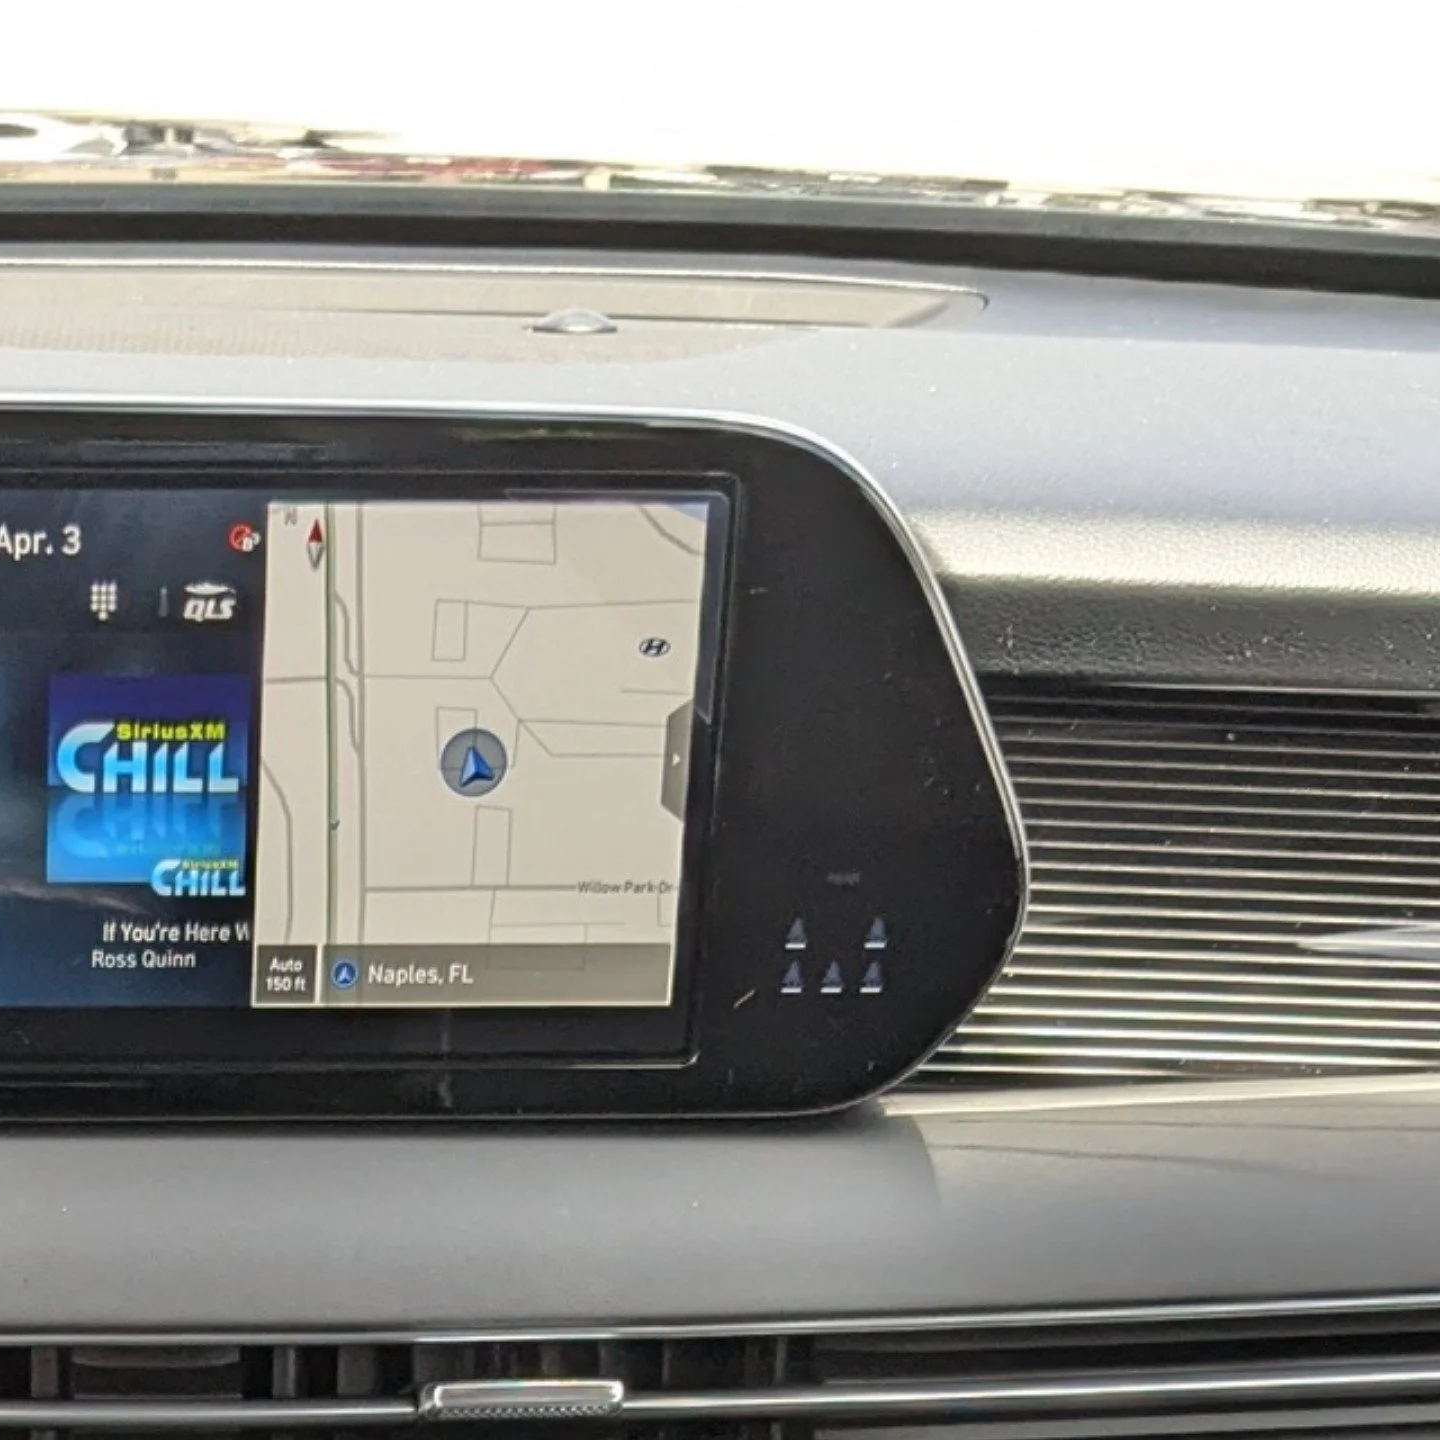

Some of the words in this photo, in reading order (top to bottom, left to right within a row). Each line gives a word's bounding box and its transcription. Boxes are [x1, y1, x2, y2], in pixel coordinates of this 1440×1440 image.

[62, 526, 82, 555] 3
[57, 722, 239, 793] CHILL
[151, 859, 246, 896] CHILL
[624, 880, 653, 893] Park
[103, 921, 116, 941] If
[121, 922, 180, 942] You're
[184, 922, 230, 941] Here
[92, 950, 136, 968] Ross
[141, 949, 196, 970] Quinn
[270, 957, 302, 972] Auto
[267, 977, 291, 992] 150
[294, 976, 306, 992] ft
[368, 964, 443, 986] Naples,
[449, 964, 473, 984] FL
